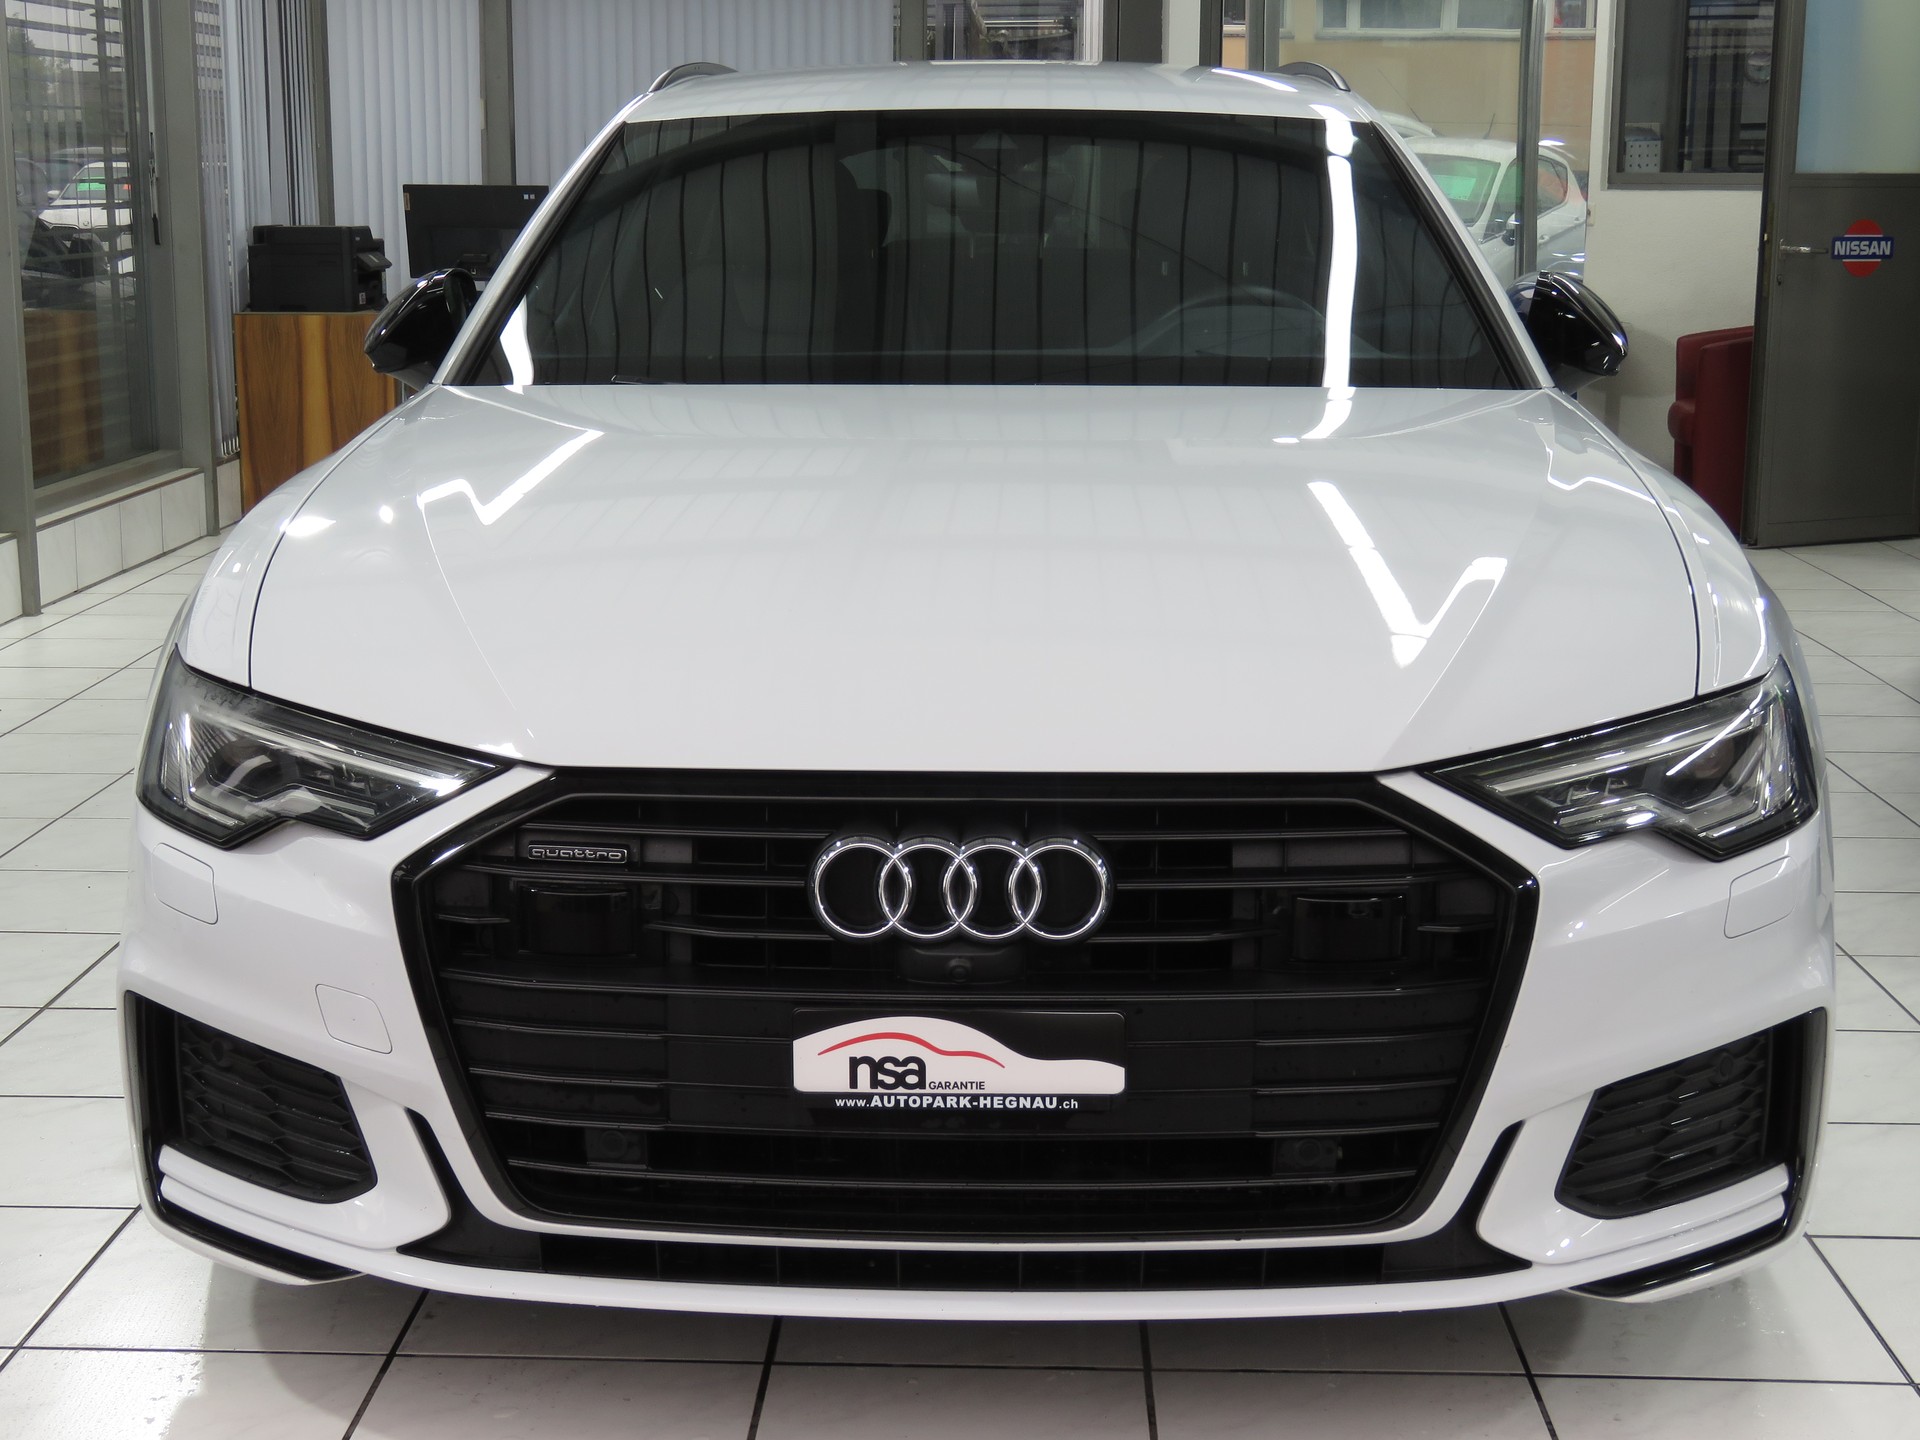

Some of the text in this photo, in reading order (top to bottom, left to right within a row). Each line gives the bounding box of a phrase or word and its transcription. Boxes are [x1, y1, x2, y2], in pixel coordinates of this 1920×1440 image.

[1833, 240, 1891, 255] NISSAN
[531, 848, 622, 860] quattro
[849, 1056, 985, 1090] nsa GARANTIE
[835, 1095, 1079, 1109] www.AUTOPARK-HEGNAU.ch
